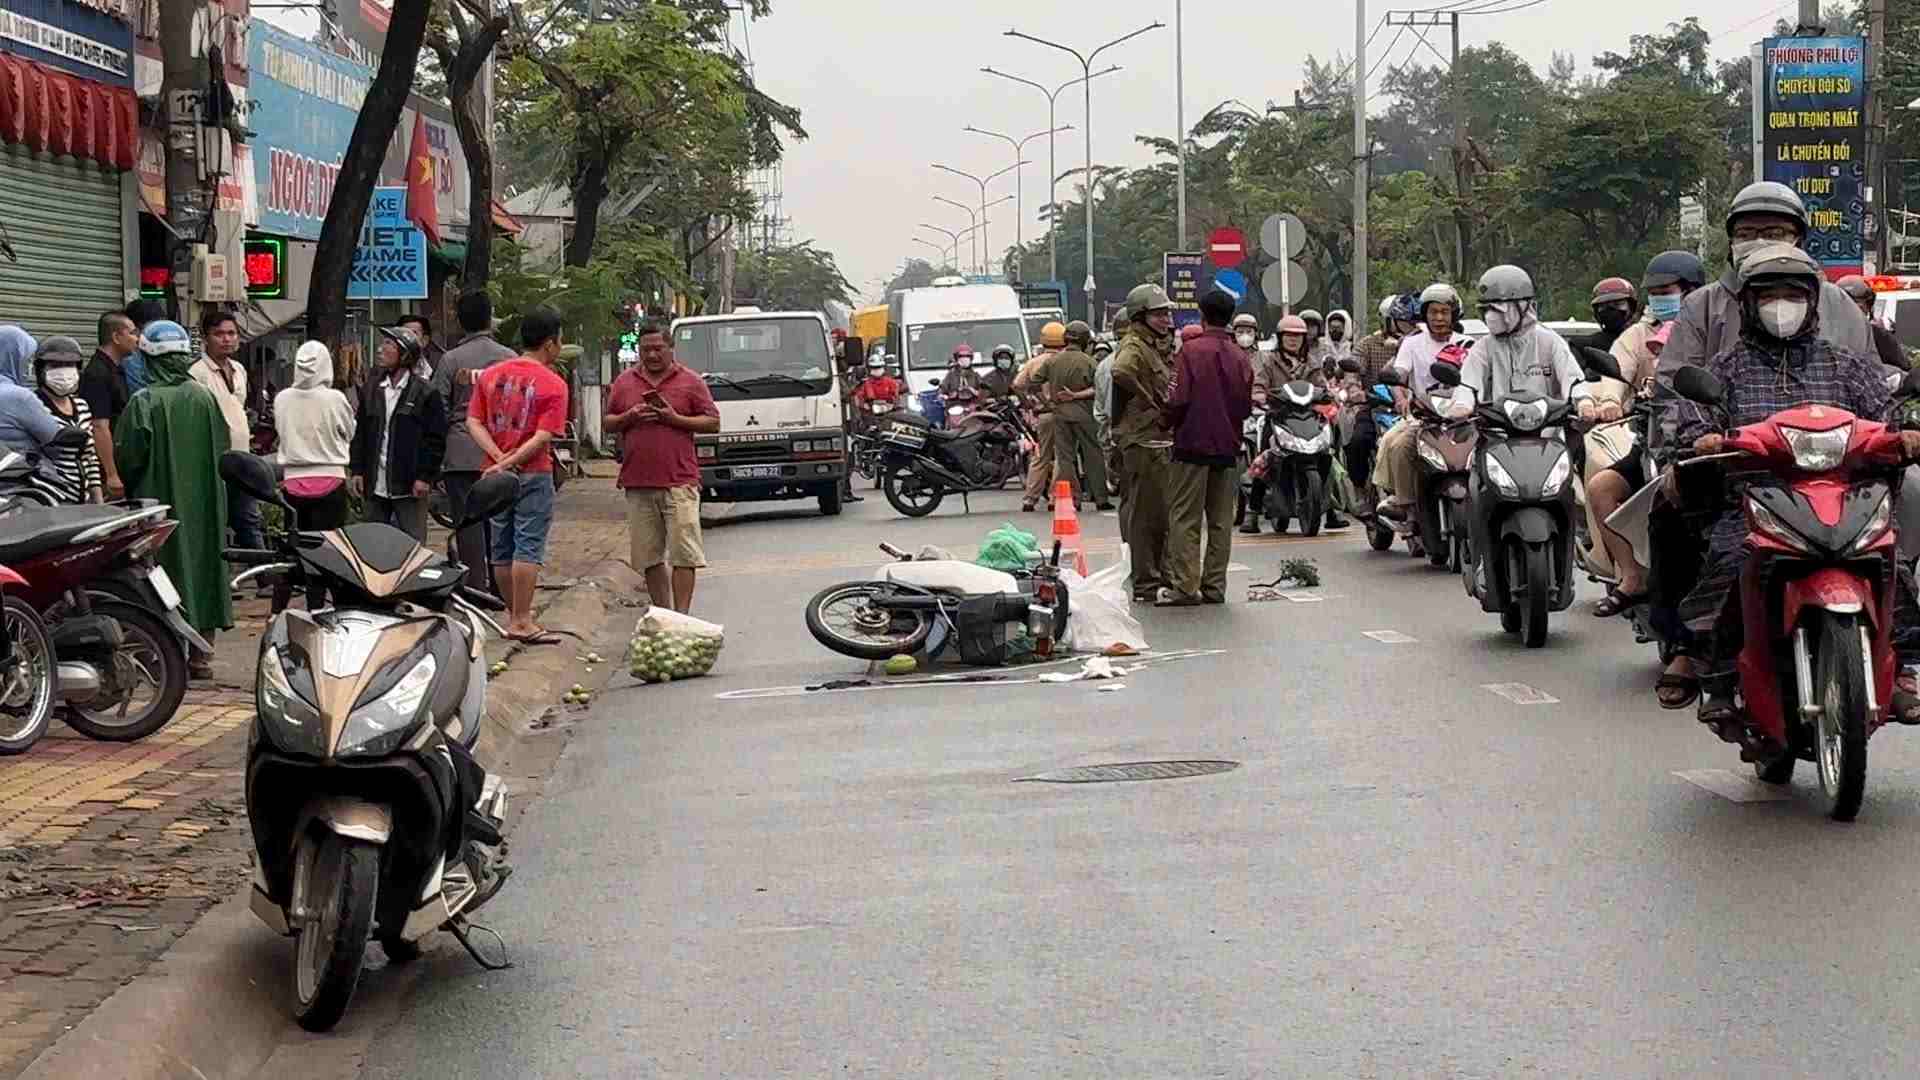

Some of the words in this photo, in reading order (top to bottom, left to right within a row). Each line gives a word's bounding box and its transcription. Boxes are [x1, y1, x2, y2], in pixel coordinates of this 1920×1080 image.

[1769, 111, 1796, 128] QUAN
[1798, 111, 1830, 129] TRỌNG
[1811, 177, 1831, 194] DUY
